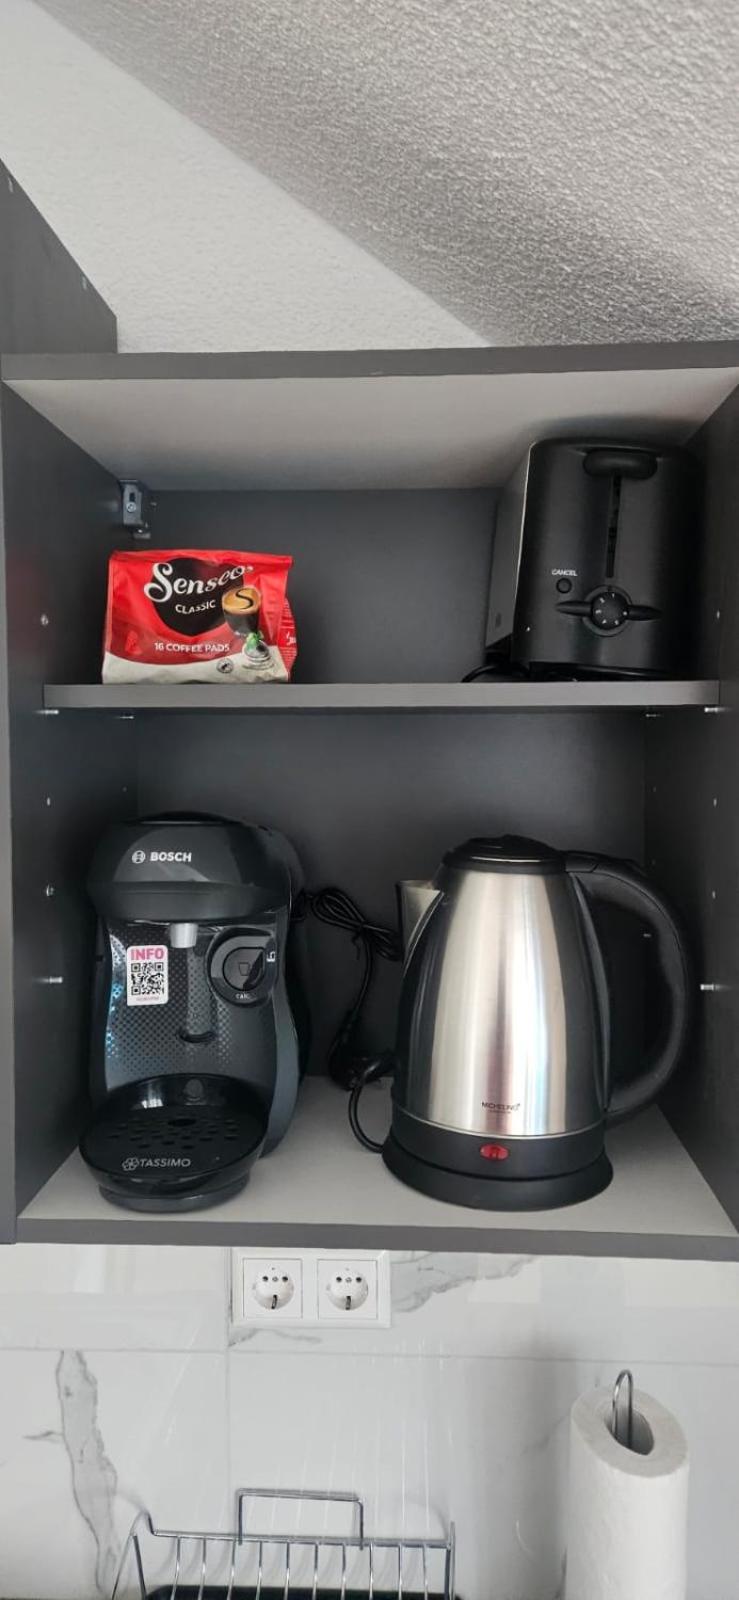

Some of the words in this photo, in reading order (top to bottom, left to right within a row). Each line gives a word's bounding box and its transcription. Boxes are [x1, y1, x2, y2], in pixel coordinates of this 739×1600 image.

[551, 568, 578, 577] CANCEL
[144, 563, 249, 603] Senseo
[175, 600, 216, 614] CLASSIC
[154, 642, 164, 651] 16
[166, 643, 201, 652] COFFEE
[205, 644, 230, 652] PADS
[150, 852, 192, 862] BOSCH
[131, 948, 164, 960] INFO
[140, 1158, 191, 1167] TASSIMO
